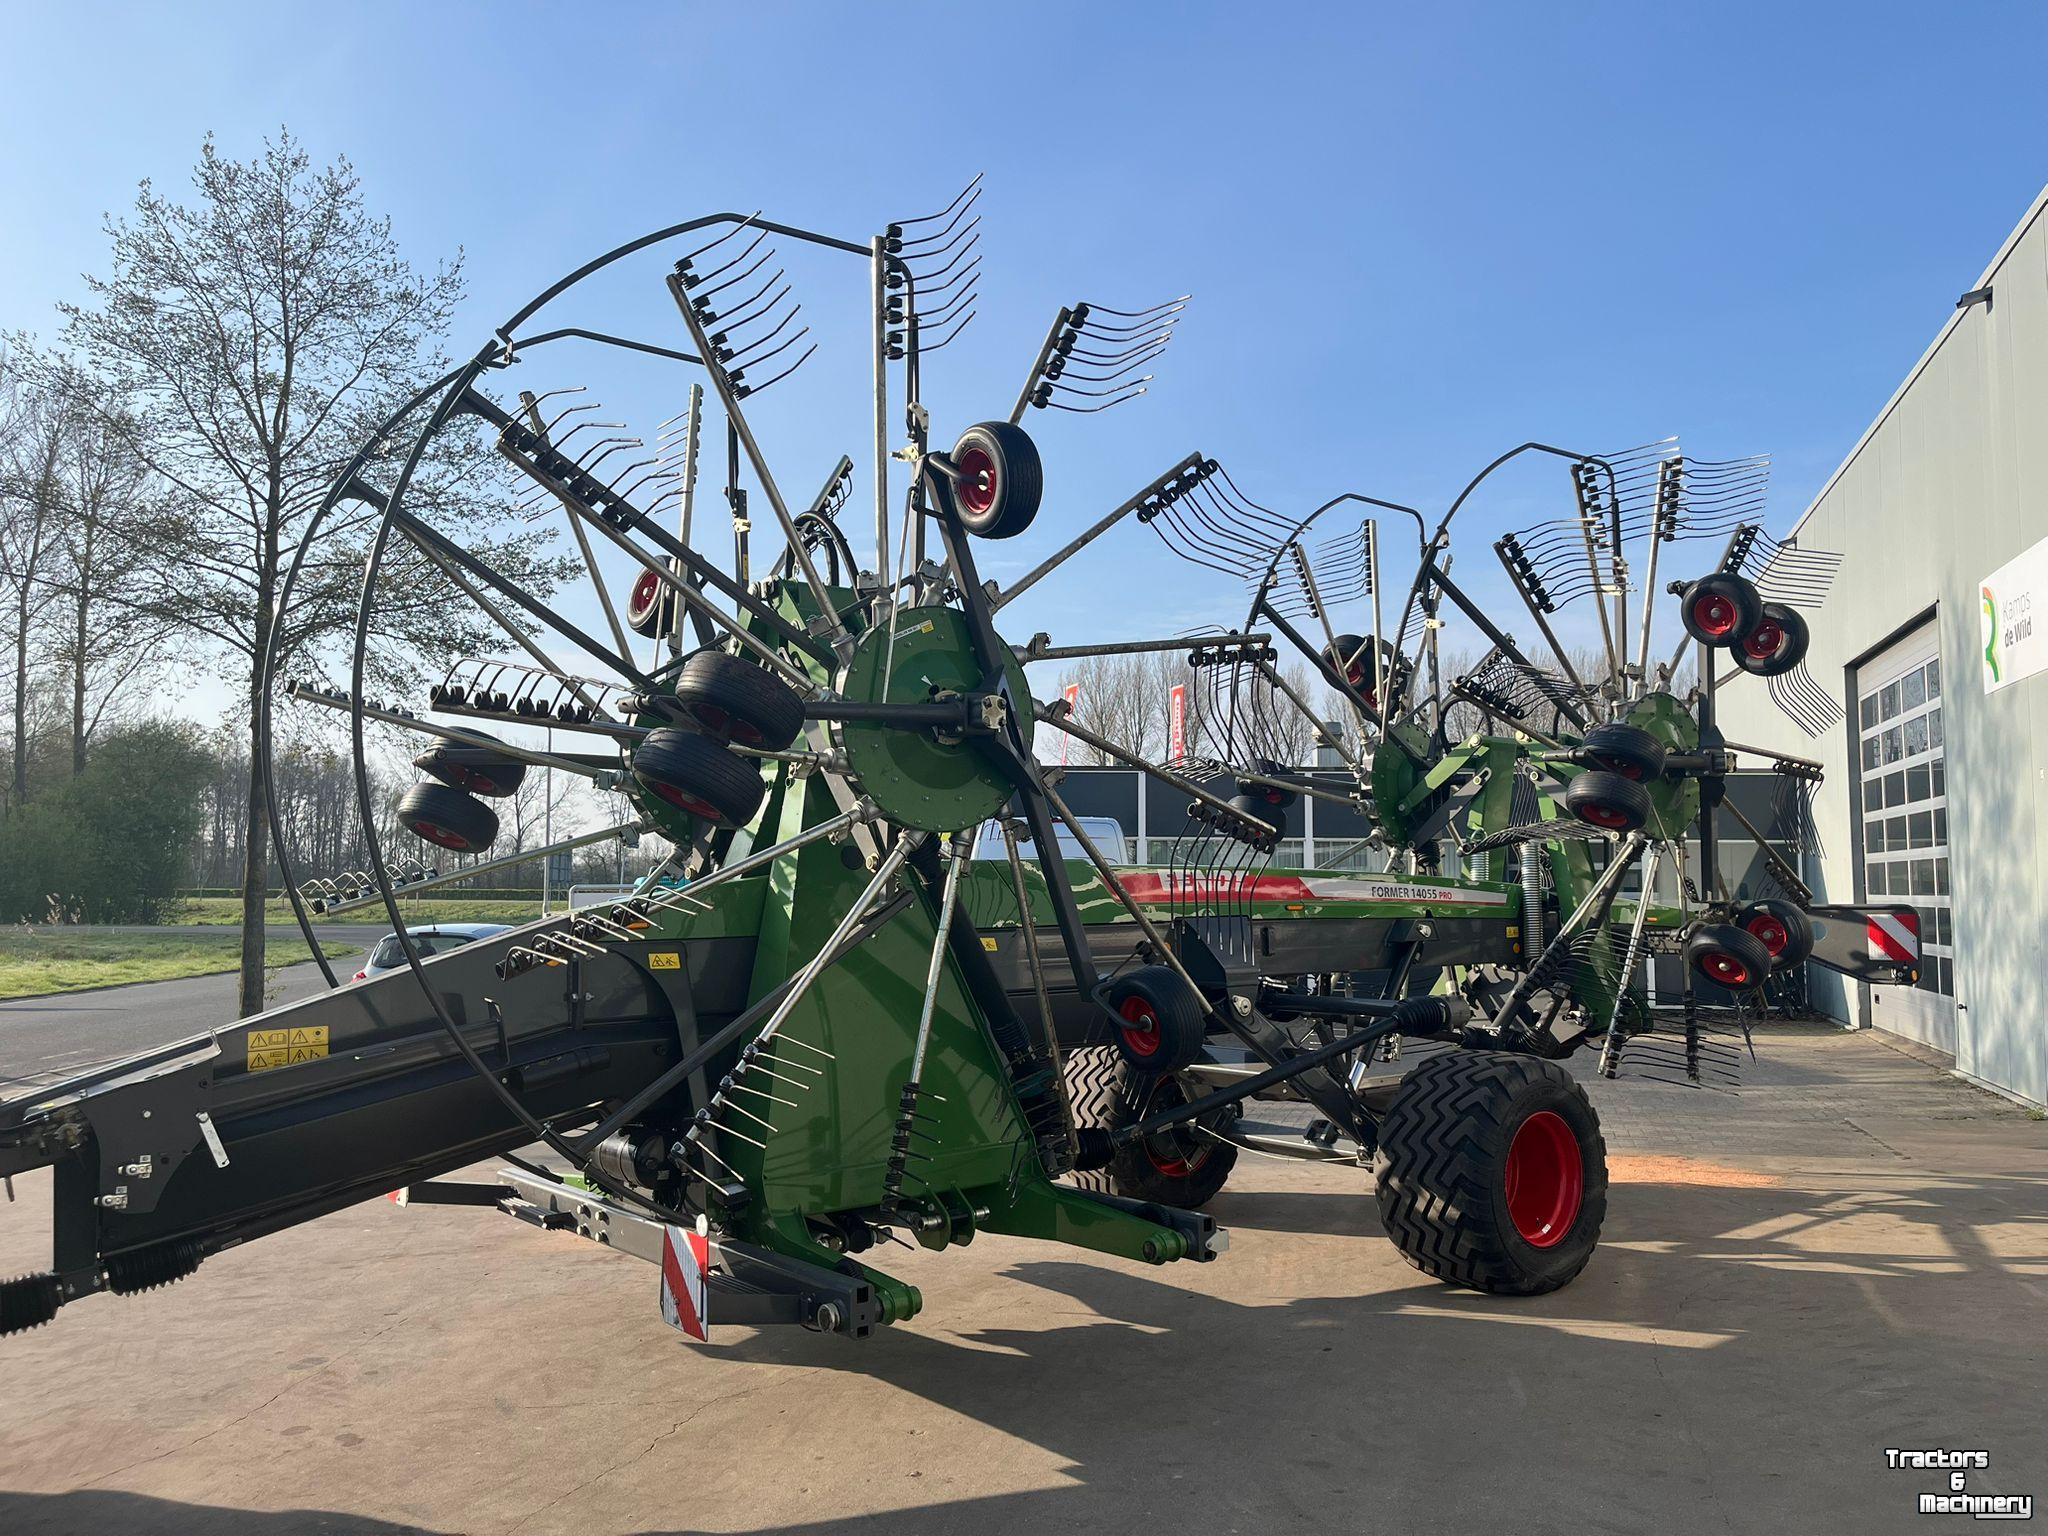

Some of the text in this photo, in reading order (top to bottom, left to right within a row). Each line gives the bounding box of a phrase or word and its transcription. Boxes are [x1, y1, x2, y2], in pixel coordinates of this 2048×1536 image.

[2001, 591, 2032, 622] Kamps
[2004, 616, 2032, 648] de Wild
[1157, 868, 1249, 892] FENDT
[1371, 886, 1453, 900] FORMER 14055 PRO
